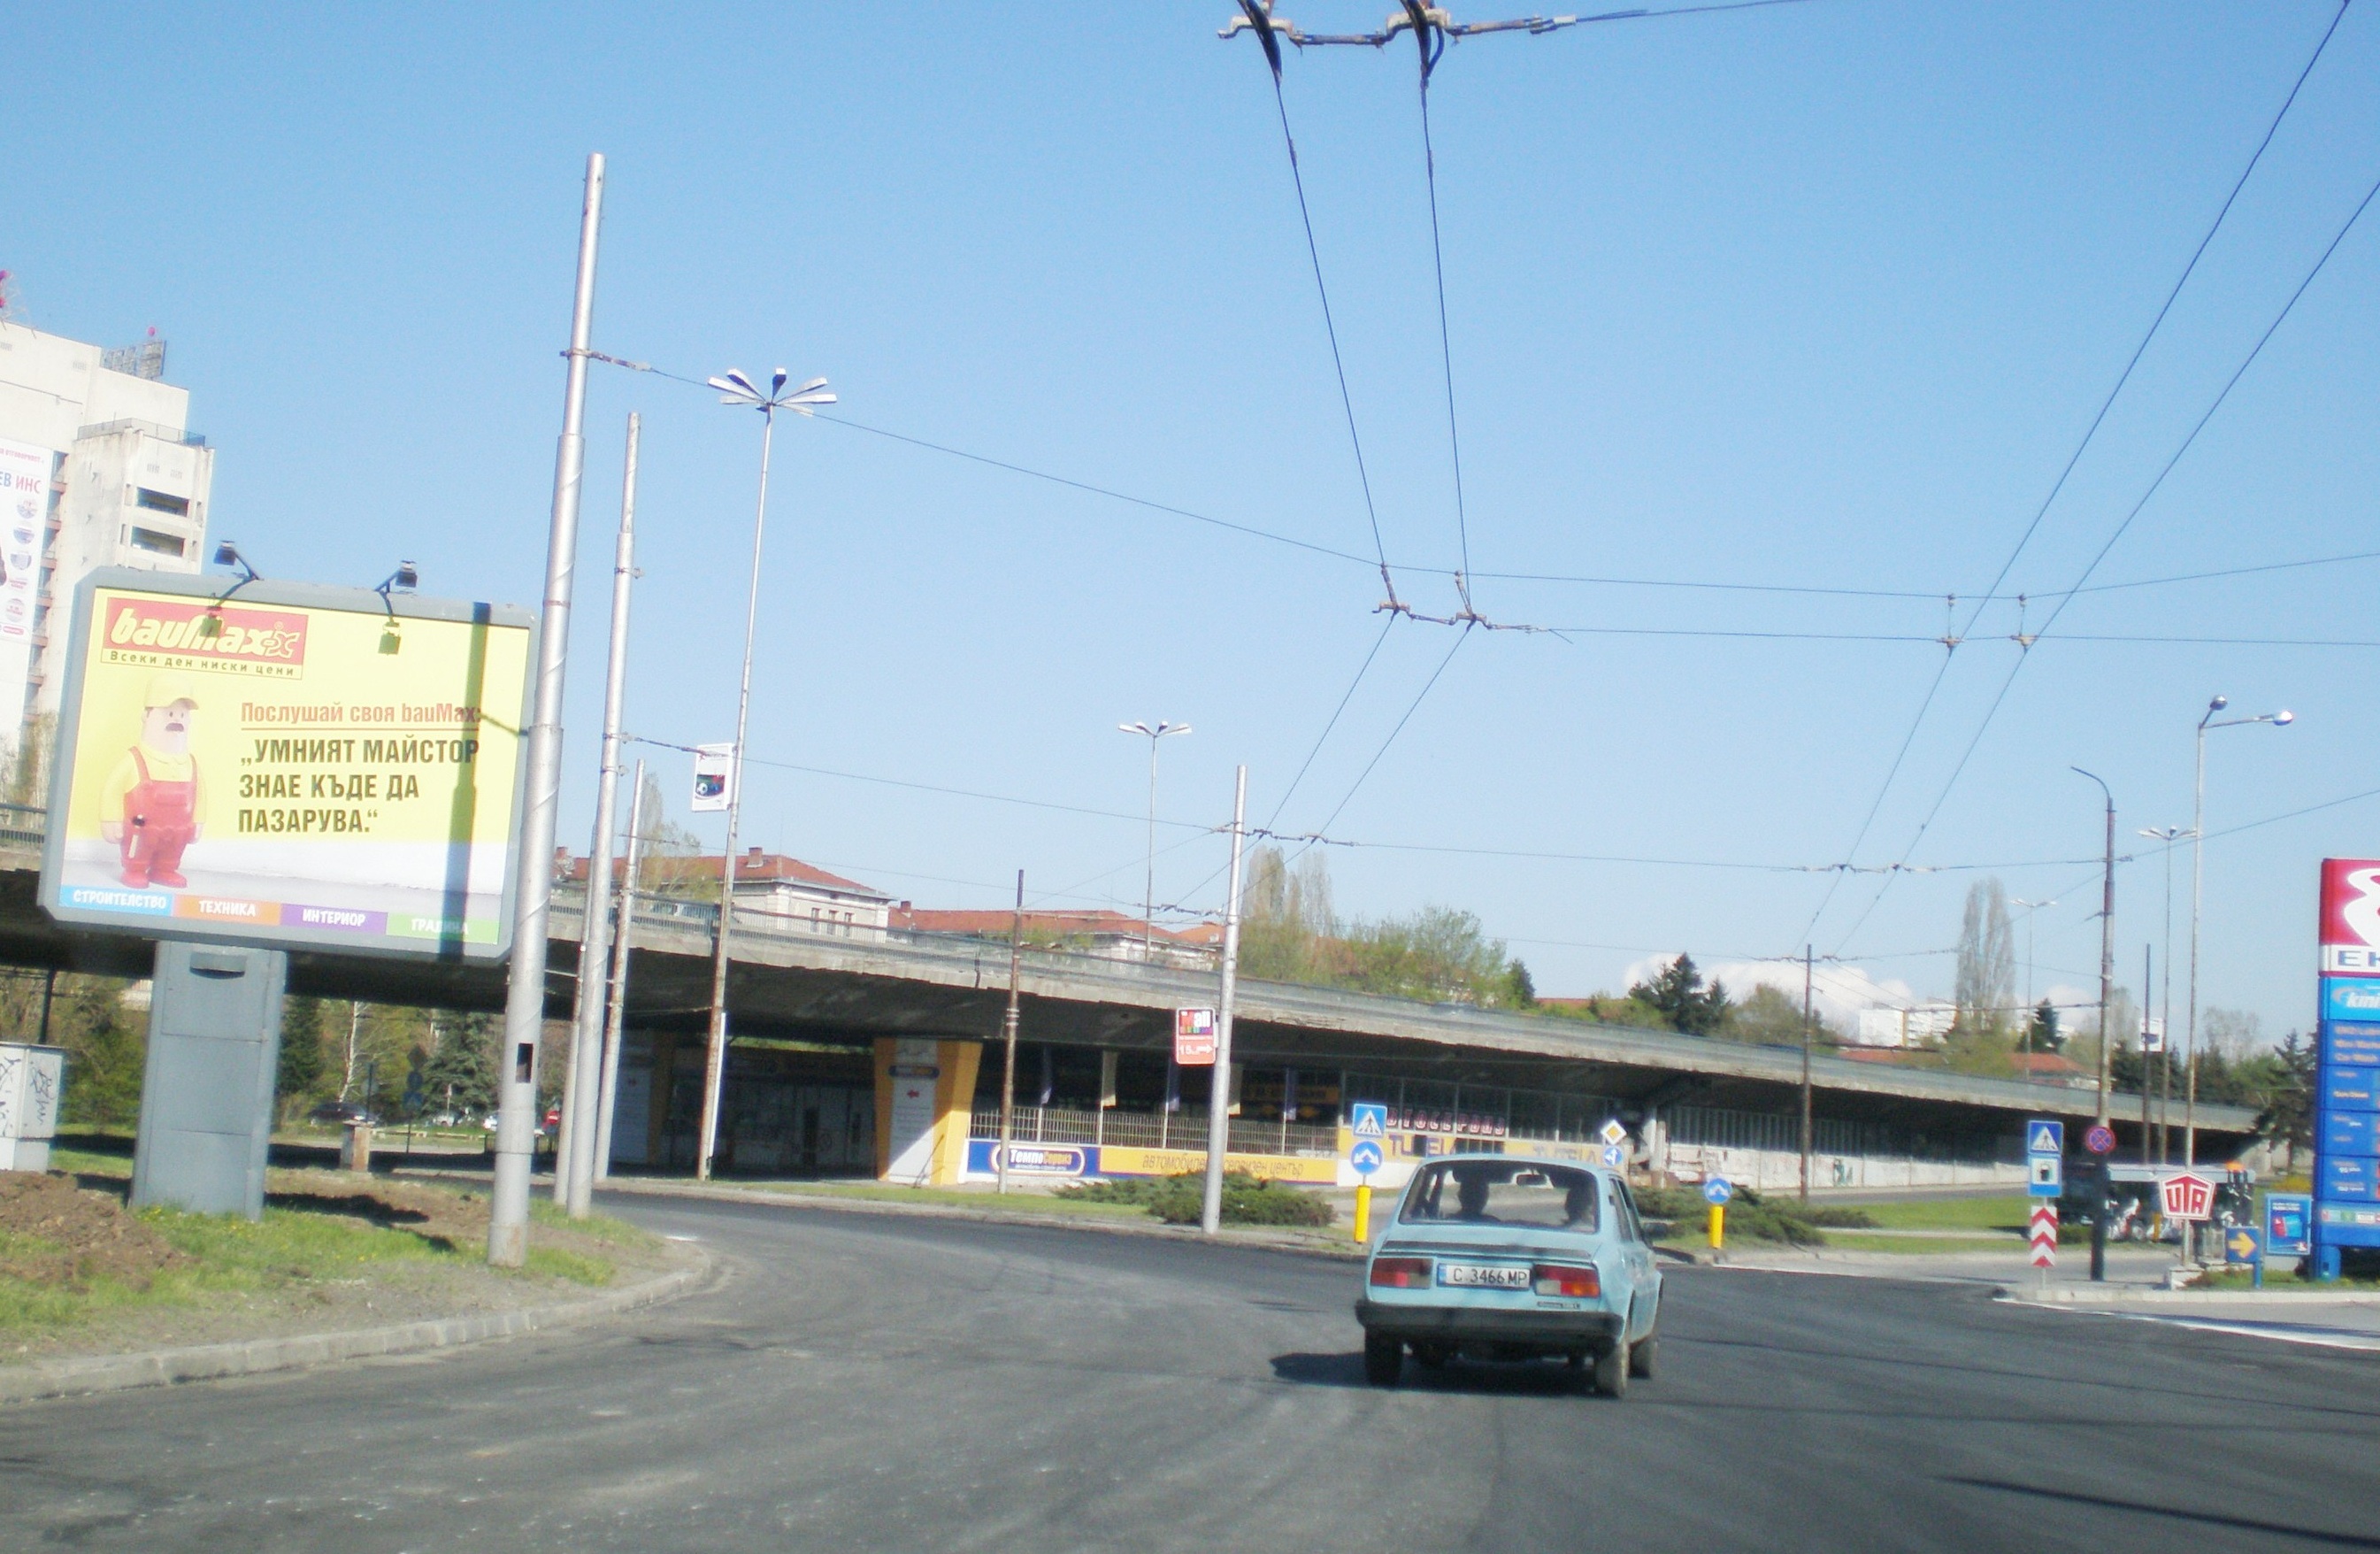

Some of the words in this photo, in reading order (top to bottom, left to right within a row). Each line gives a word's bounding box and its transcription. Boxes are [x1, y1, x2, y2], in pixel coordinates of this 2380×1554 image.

[15, 474, 42, 494] ИНС
[111, 650, 157, 664] Всеки
[165, 656, 192, 667] ден
[201, 660, 248, 672] ниски
[256, 665, 294, 676] цени
[241, 701, 343, 724] Послушай
[349, 705, 395, 722] своя
[363, 734, 479, 764] МАЙСТОР
[239, 773, 302, 798] ЗНАЕ
[311, 773, 377, 801] КЪДЕ
[386, 774, 419, 801] ДА
[73, 889, 167, 910] СТРОИТЕЛСТВО
[198, 900, 257, 917] ТЕХНИКА
[302, 908, 366, 927] ИНТЕРИОР
[1386, 1106, 1505, 1136] ВТОСЕРВИЗ
[1142, 1154, 1208, 1171] автомобиле
[2164, 1175, 2210, 1215] UTA
[1453, 1268, 1463, 1282] C
[1470, 1269, 1506, 1283] 3466
[1508, 1271, 1528, 1285] MP
